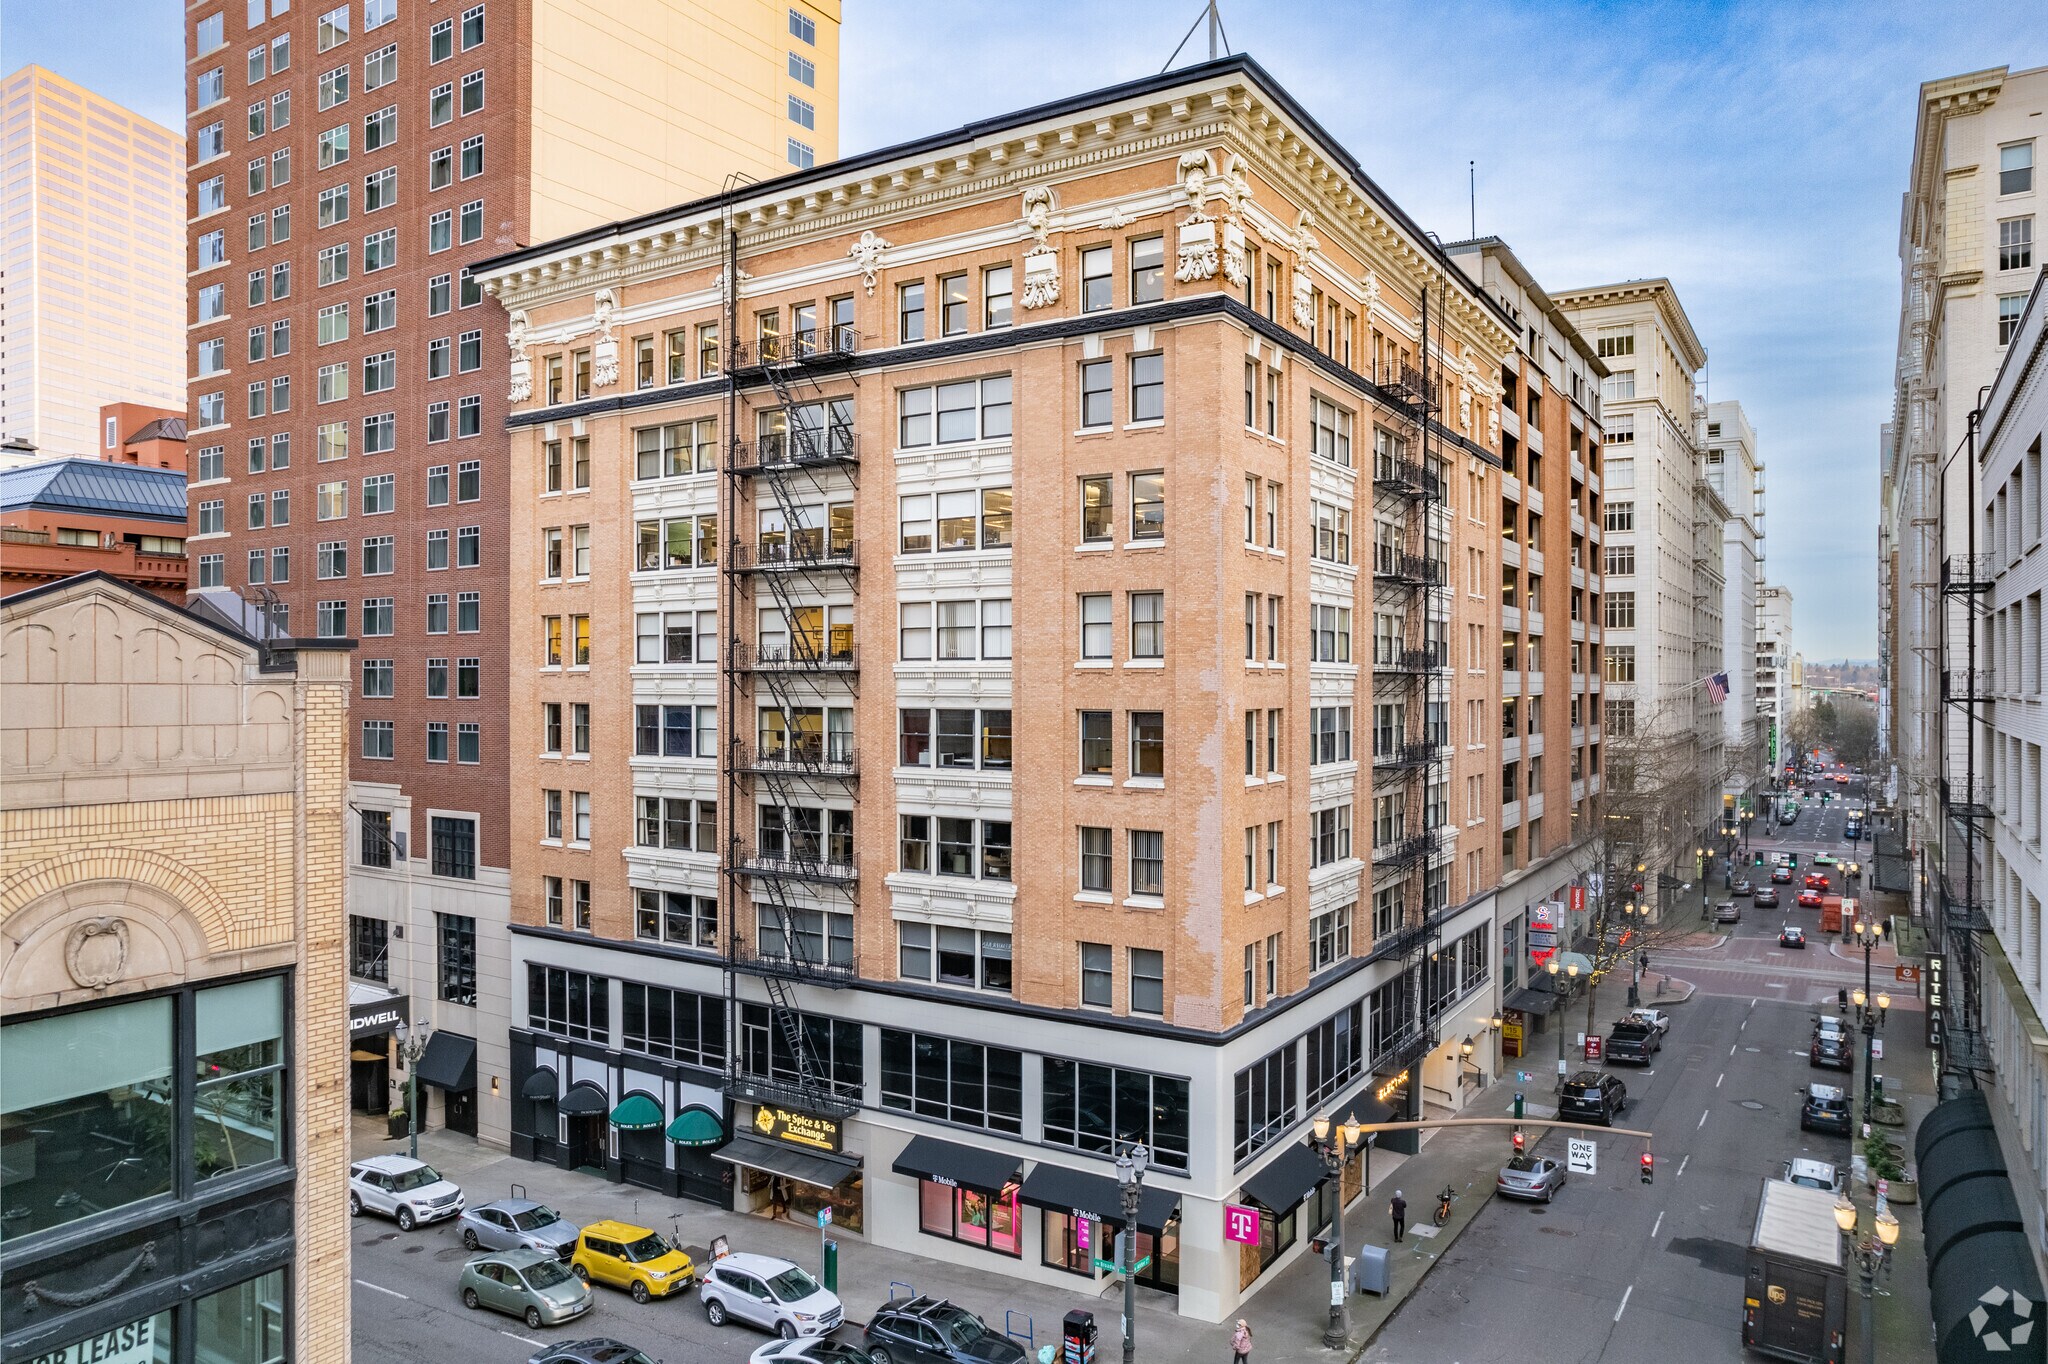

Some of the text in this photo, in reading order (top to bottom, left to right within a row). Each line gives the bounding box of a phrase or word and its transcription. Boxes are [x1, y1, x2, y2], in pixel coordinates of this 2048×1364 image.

[1930, 959, 1941, 1006] RITE
[1930, 1010, 1940, 1044] AID
[1378, 1069, 1409, 1101] ELECTRIC
[776, 1109, 836, 1133] The Spice & Tea
[788, 1123, 826, 1141] Exchange
[1571, 1142, 1592, 1152] ONE
[1571, 1151, 1592, 1160] WAY
[938, 1175, 958, 1187] Mobile
[1079, 1209, 1101, 1222] Mobile
[1231, 1212, 1252, 1239] T
[1770, 1290, 1785, 1301] ups
[78, 1318, 150, 1364] LEASE
